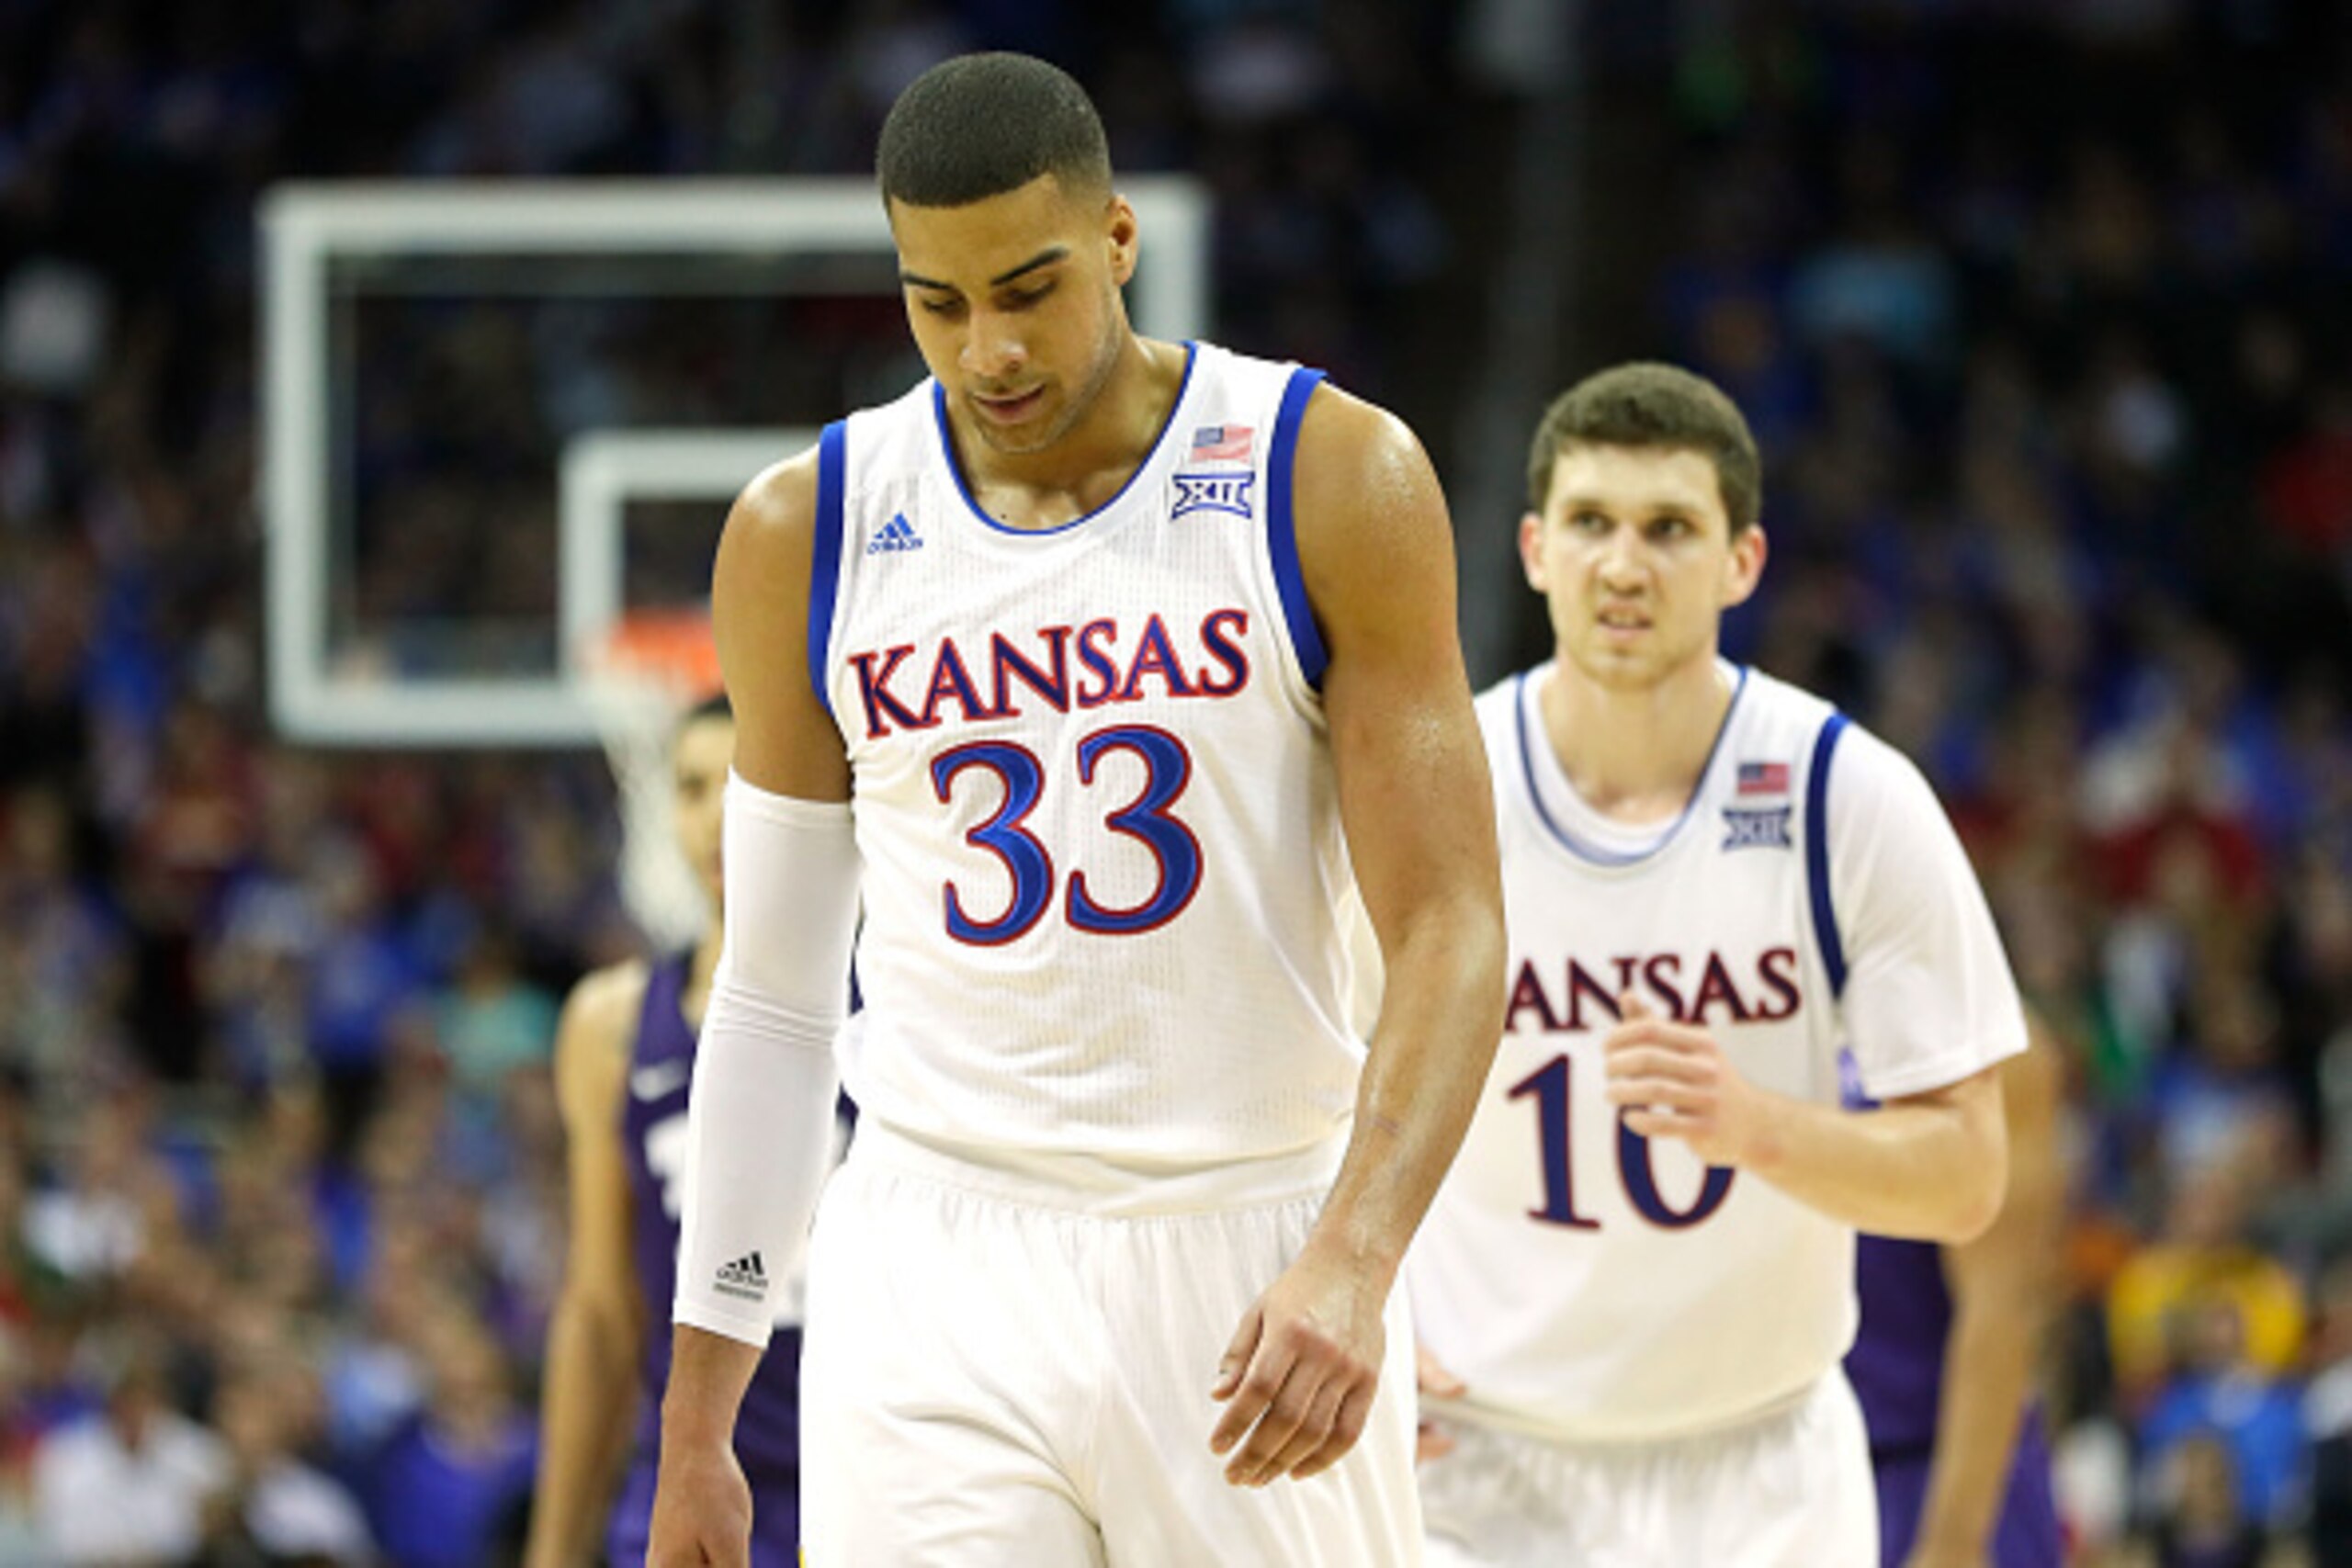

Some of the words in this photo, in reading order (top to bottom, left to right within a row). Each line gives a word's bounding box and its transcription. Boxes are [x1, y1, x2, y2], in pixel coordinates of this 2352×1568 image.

[847, 608, 1250, 739] KANSAS
[930, 724, 1204, 947] 33
[1504, 947, 1802, 1033] ANSAS
